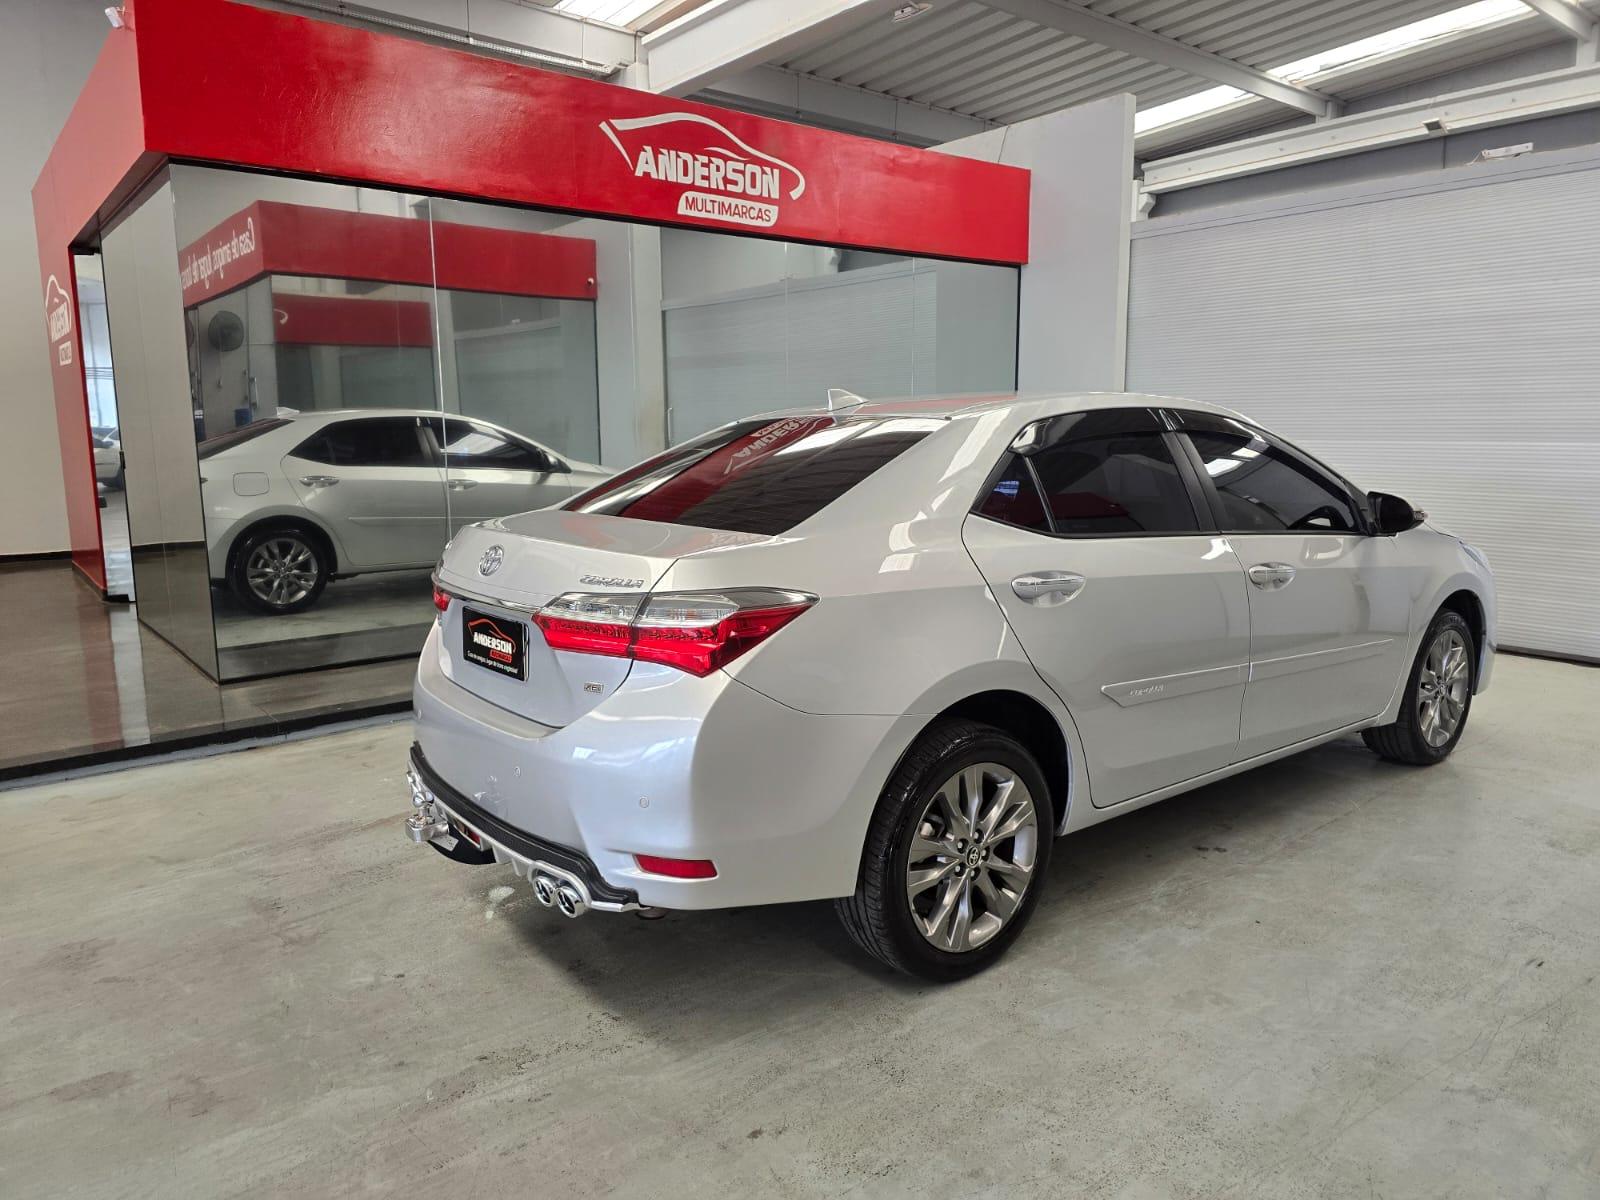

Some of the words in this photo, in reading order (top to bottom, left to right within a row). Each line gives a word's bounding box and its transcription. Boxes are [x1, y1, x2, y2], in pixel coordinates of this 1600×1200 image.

[635, 145, 780, 199] ANDERSON
[684, 196, 772, 223] MULTIMARCAS
[473, 631, 513, 655] ANDERSON
